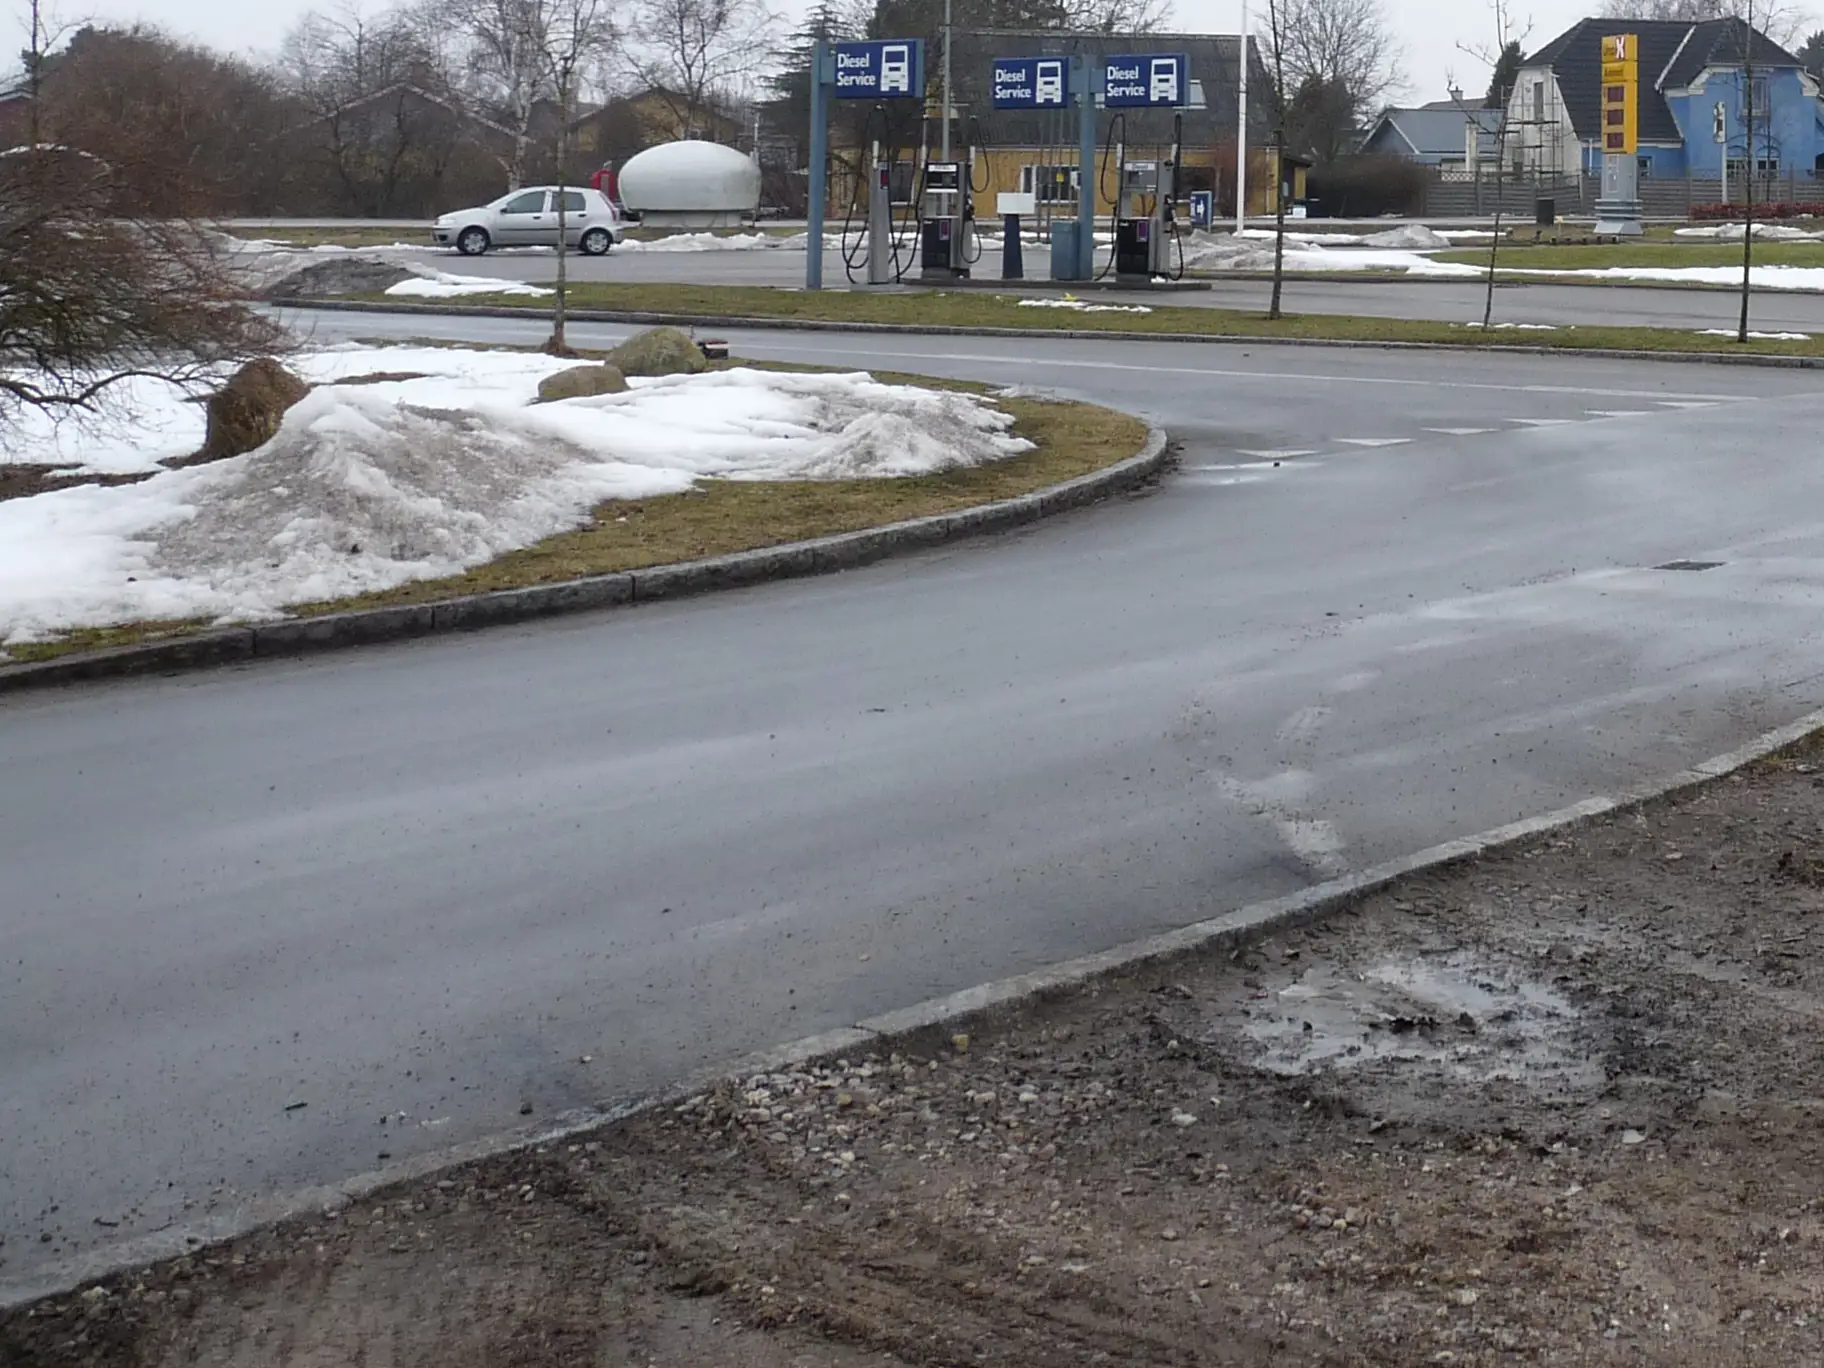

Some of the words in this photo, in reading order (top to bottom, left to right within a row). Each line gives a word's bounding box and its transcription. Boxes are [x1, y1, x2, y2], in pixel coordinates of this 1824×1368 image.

[837, 52, 870, 68] Diesel
[837, 70, 876, 87] Service
[995, 69, 1026, 83] Diesel
[1106, 65, 1139, 80] Diesel
[995, 85, 1032, 99] Service
[1106, 82, 1146, 97] Service
